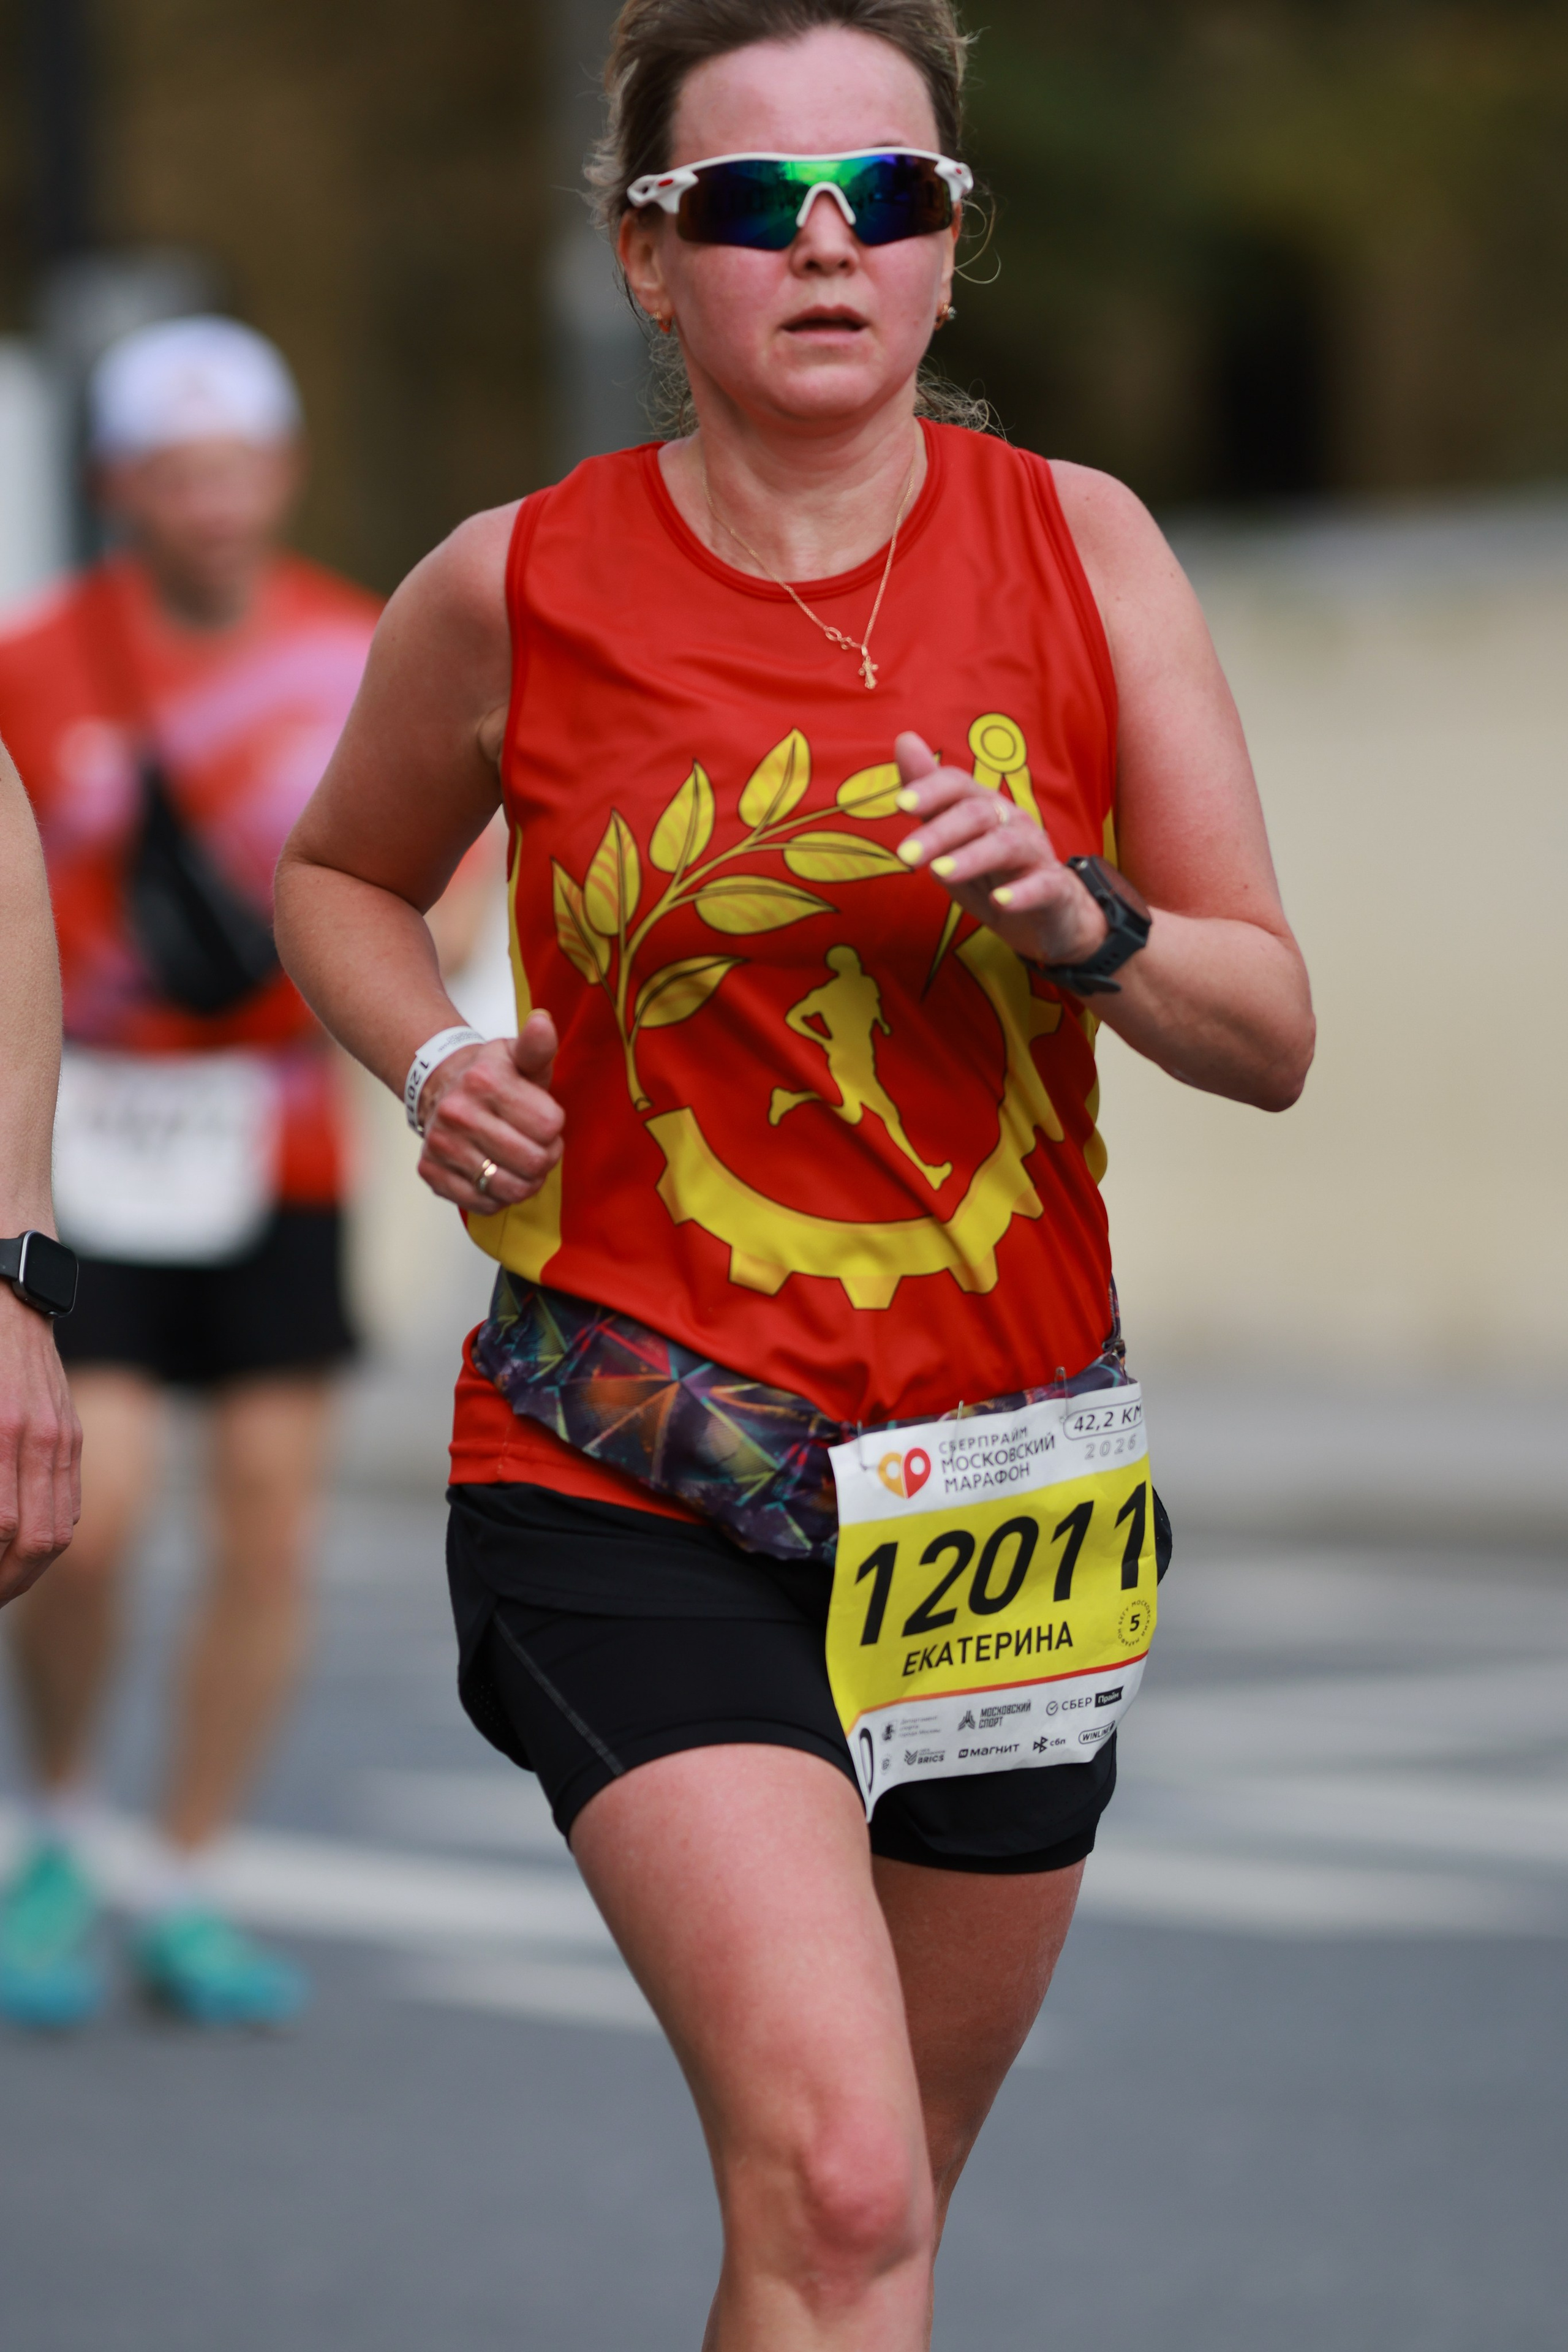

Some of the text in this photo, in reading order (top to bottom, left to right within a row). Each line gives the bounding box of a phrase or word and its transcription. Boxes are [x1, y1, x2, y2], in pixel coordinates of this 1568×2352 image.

[1074, 1411, 1113, 1431] 42,2
[938, 1427, 1027, 1454] СБЕРПРАЙМ
[1085, 1434, 1136, 1460] 2026
[941, 1433, 1055, 1474] МОСКОВСКИЙ
[945, 1462, 1030, 1493] МАРАФОН
[854, 1480, 1147, 1647] 12011
[1129, 1613, 1140, 1632] 5
[902, 1621, 1073, 1676] ЕКАТЕРИНА
[980, 1700, 1031, 1717] МОСКОВСКИЙ
[1061, 1697, 1092, 1711] СБЕР
[979, 1716, 1003, 1728] СПОРТ
[918, 1754, 944, 1764] BRICS
